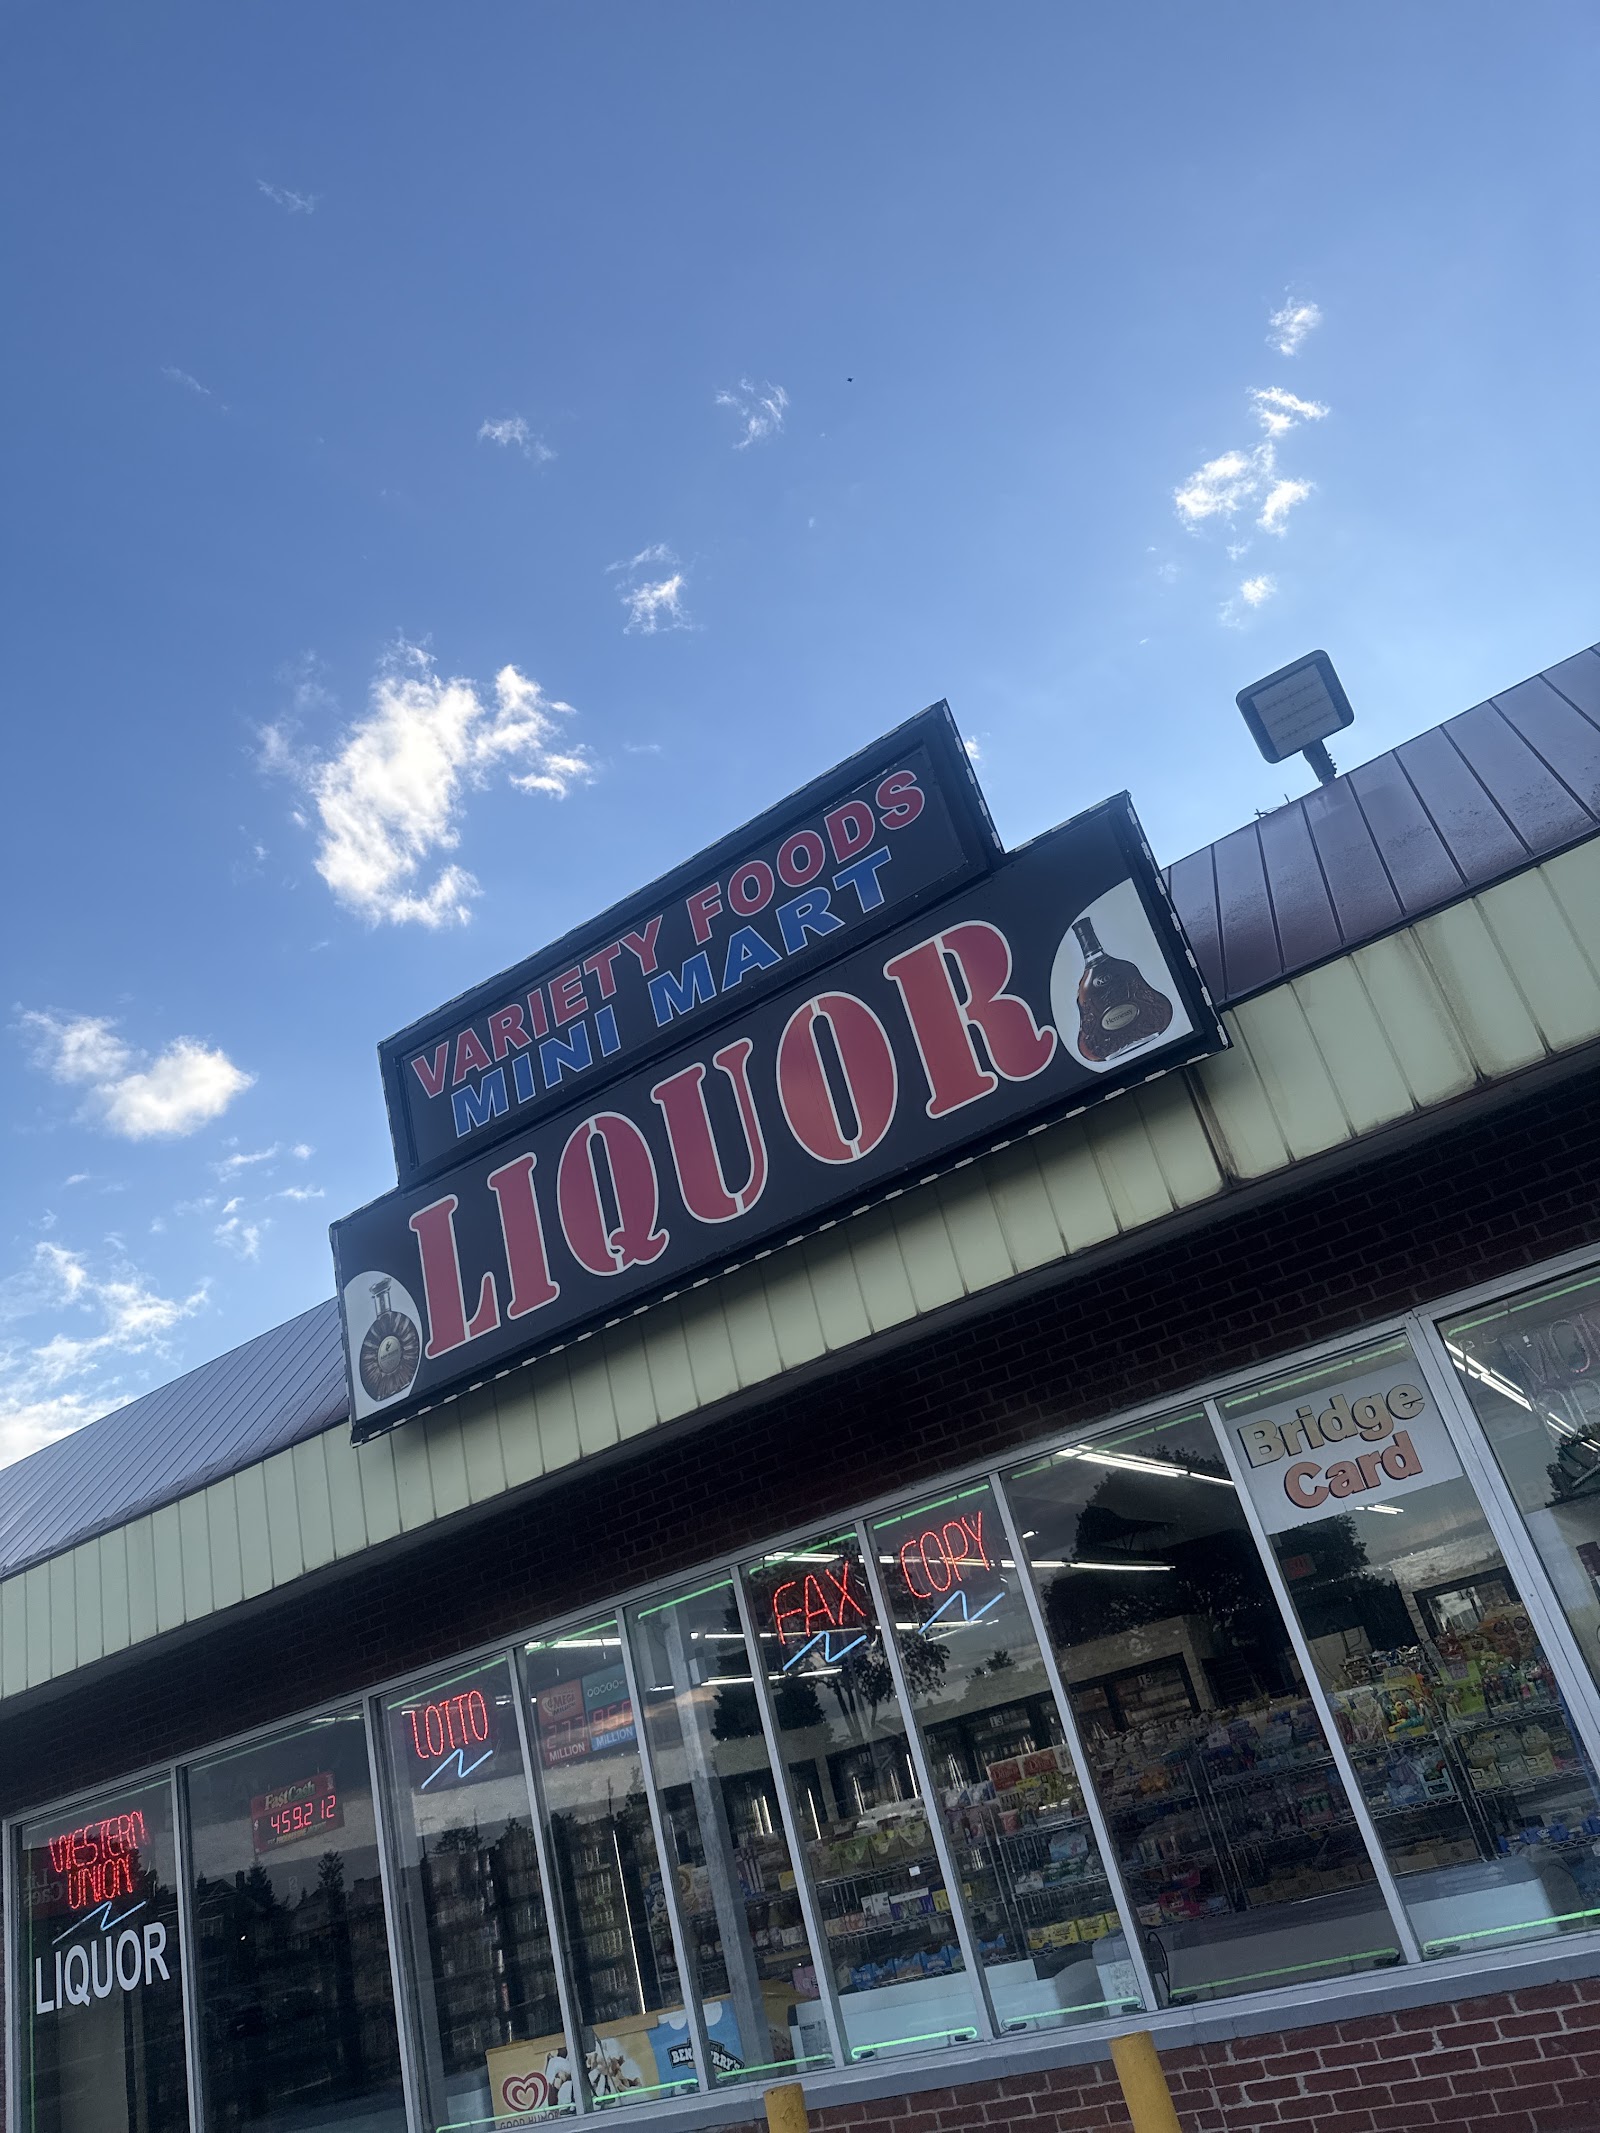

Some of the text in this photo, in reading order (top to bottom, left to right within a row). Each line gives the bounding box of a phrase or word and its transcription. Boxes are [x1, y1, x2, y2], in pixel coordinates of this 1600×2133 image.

[411, 769, 925, 1099] VARIETY FOODS
[450, 845, 891, 1138] MINI MART
[1105, 1009, 1133, 1025] Hennessy
[409, 920, 1058, 1359] LIQUOR
[1237, 1383, 1425, 1469] Bridge
[1283, 1430, 1423, 1509] Card
[900, 1511, 990, 1598] COPY
[773, 1560, 867, 1645] FAX
[411, 1690, 489, 1759] LOTTO
[549, 1742, 585, 1761] MILLION
[596, 1727, 633, 1747] MILLION
[49, 1810, 147, 1873] WESTERN
[68, 1854, 133, 1910] UNION
[35, 1922, 170, 2015] LIQUOR
